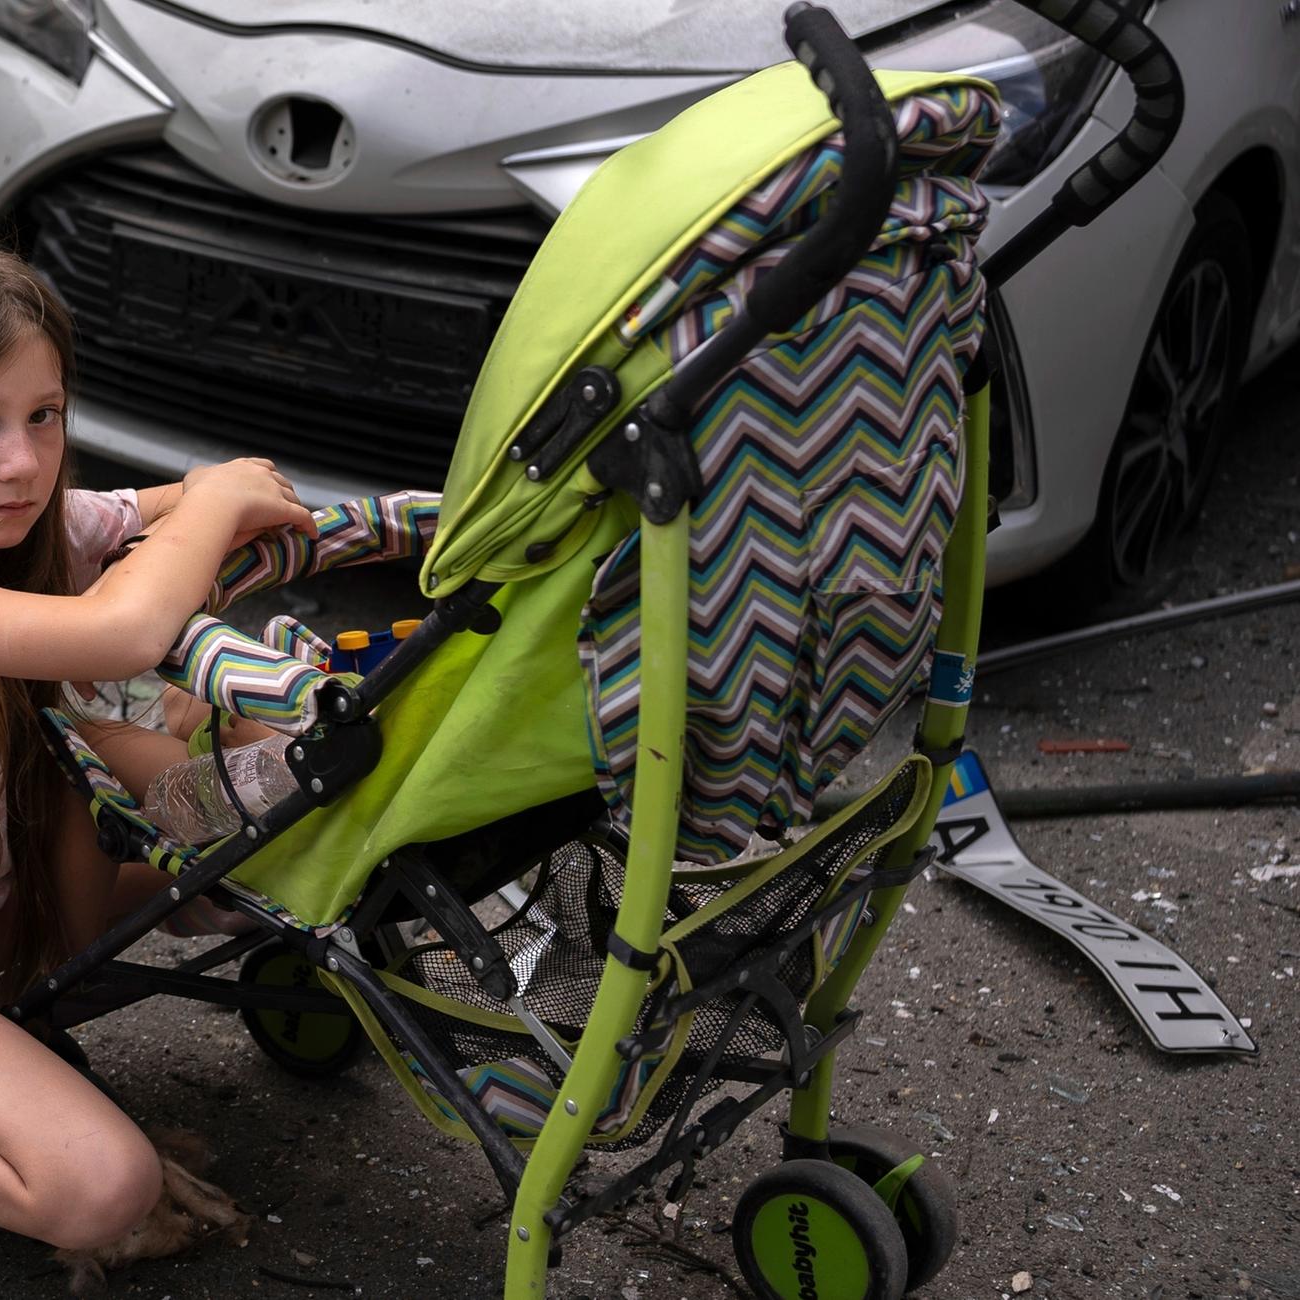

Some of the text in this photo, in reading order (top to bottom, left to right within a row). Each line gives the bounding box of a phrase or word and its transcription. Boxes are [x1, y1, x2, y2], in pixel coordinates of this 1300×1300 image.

[934, 817, 1226, 1020] AI 1970 IH
